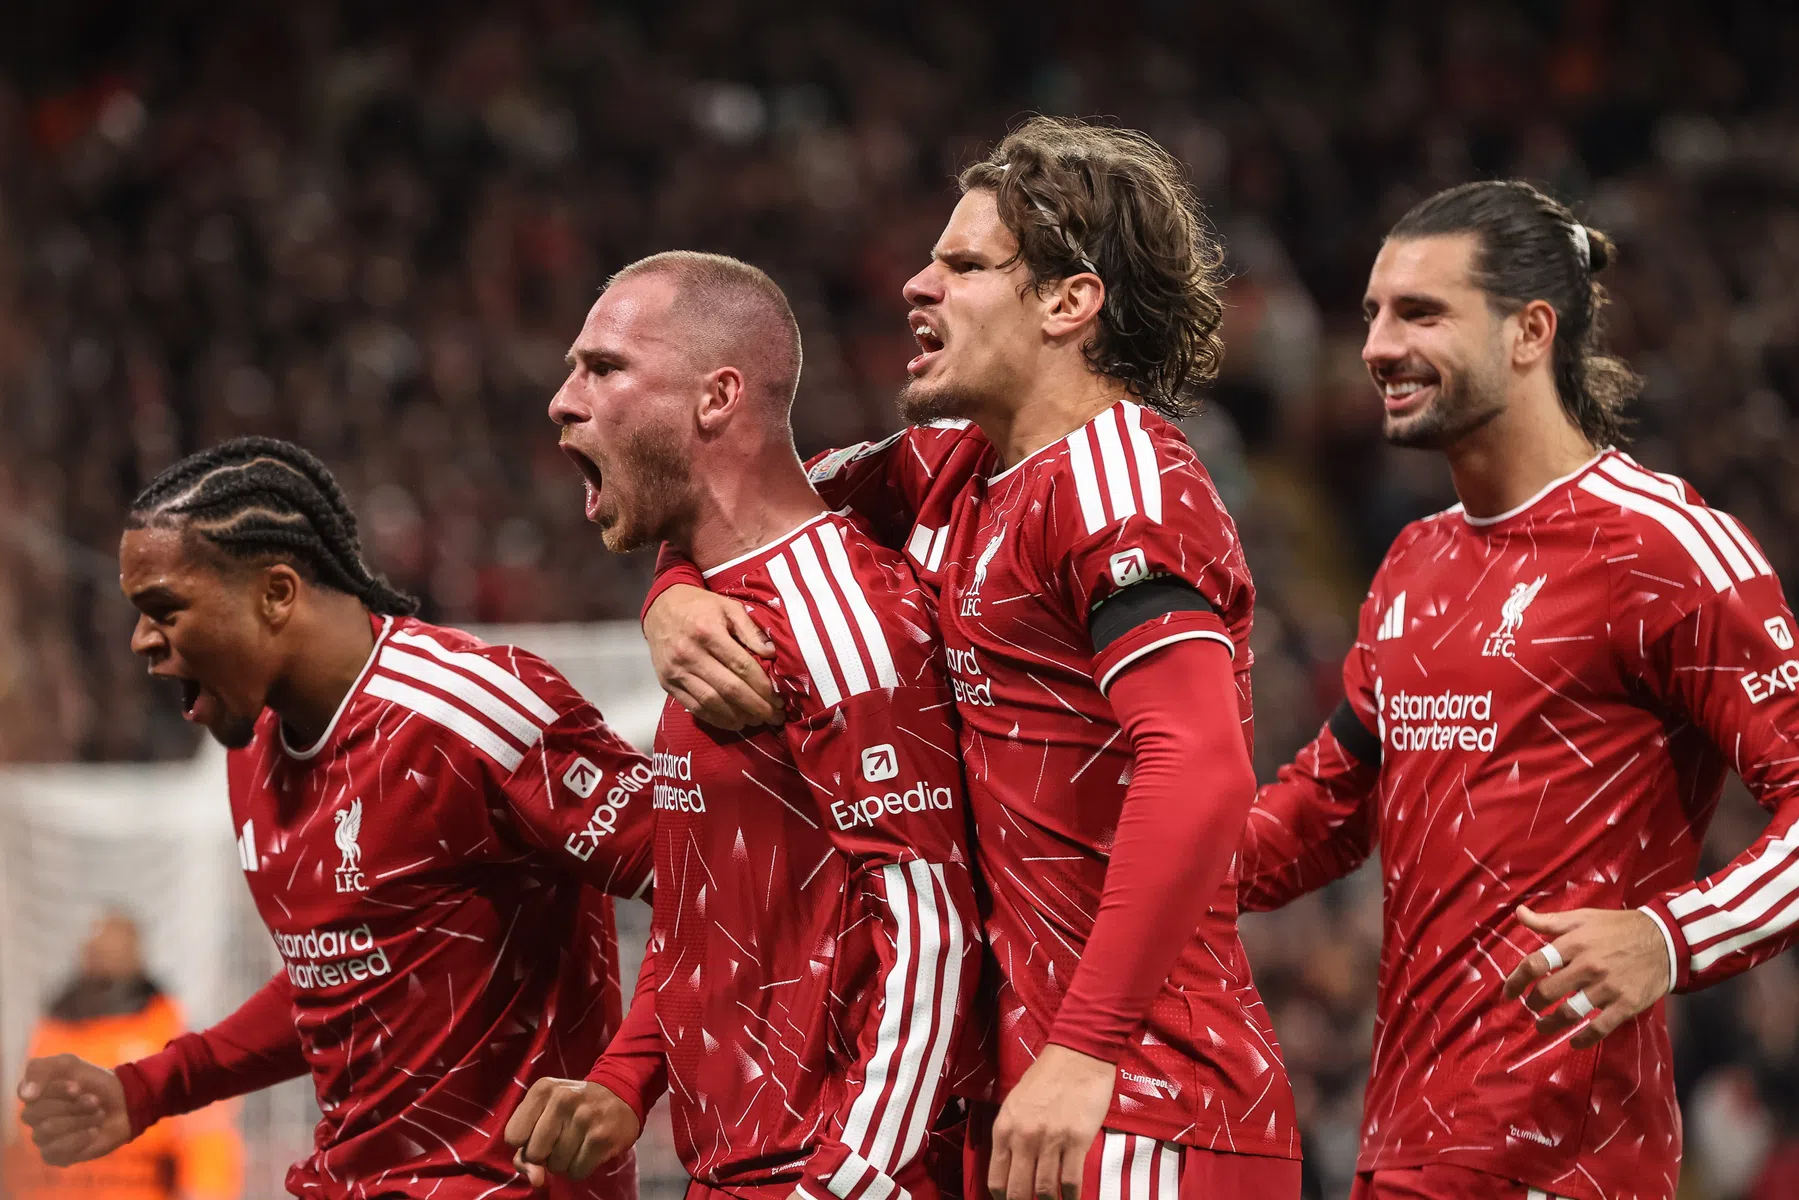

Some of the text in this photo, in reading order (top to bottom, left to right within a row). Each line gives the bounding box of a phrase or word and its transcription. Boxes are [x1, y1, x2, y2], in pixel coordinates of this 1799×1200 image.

[1390, 689, 1492, 721] standard
[1390, 720, 1498, 752] chartered
[564, 762, 653, 862] Expedia
[829, 780, 953, 831] Expedia
